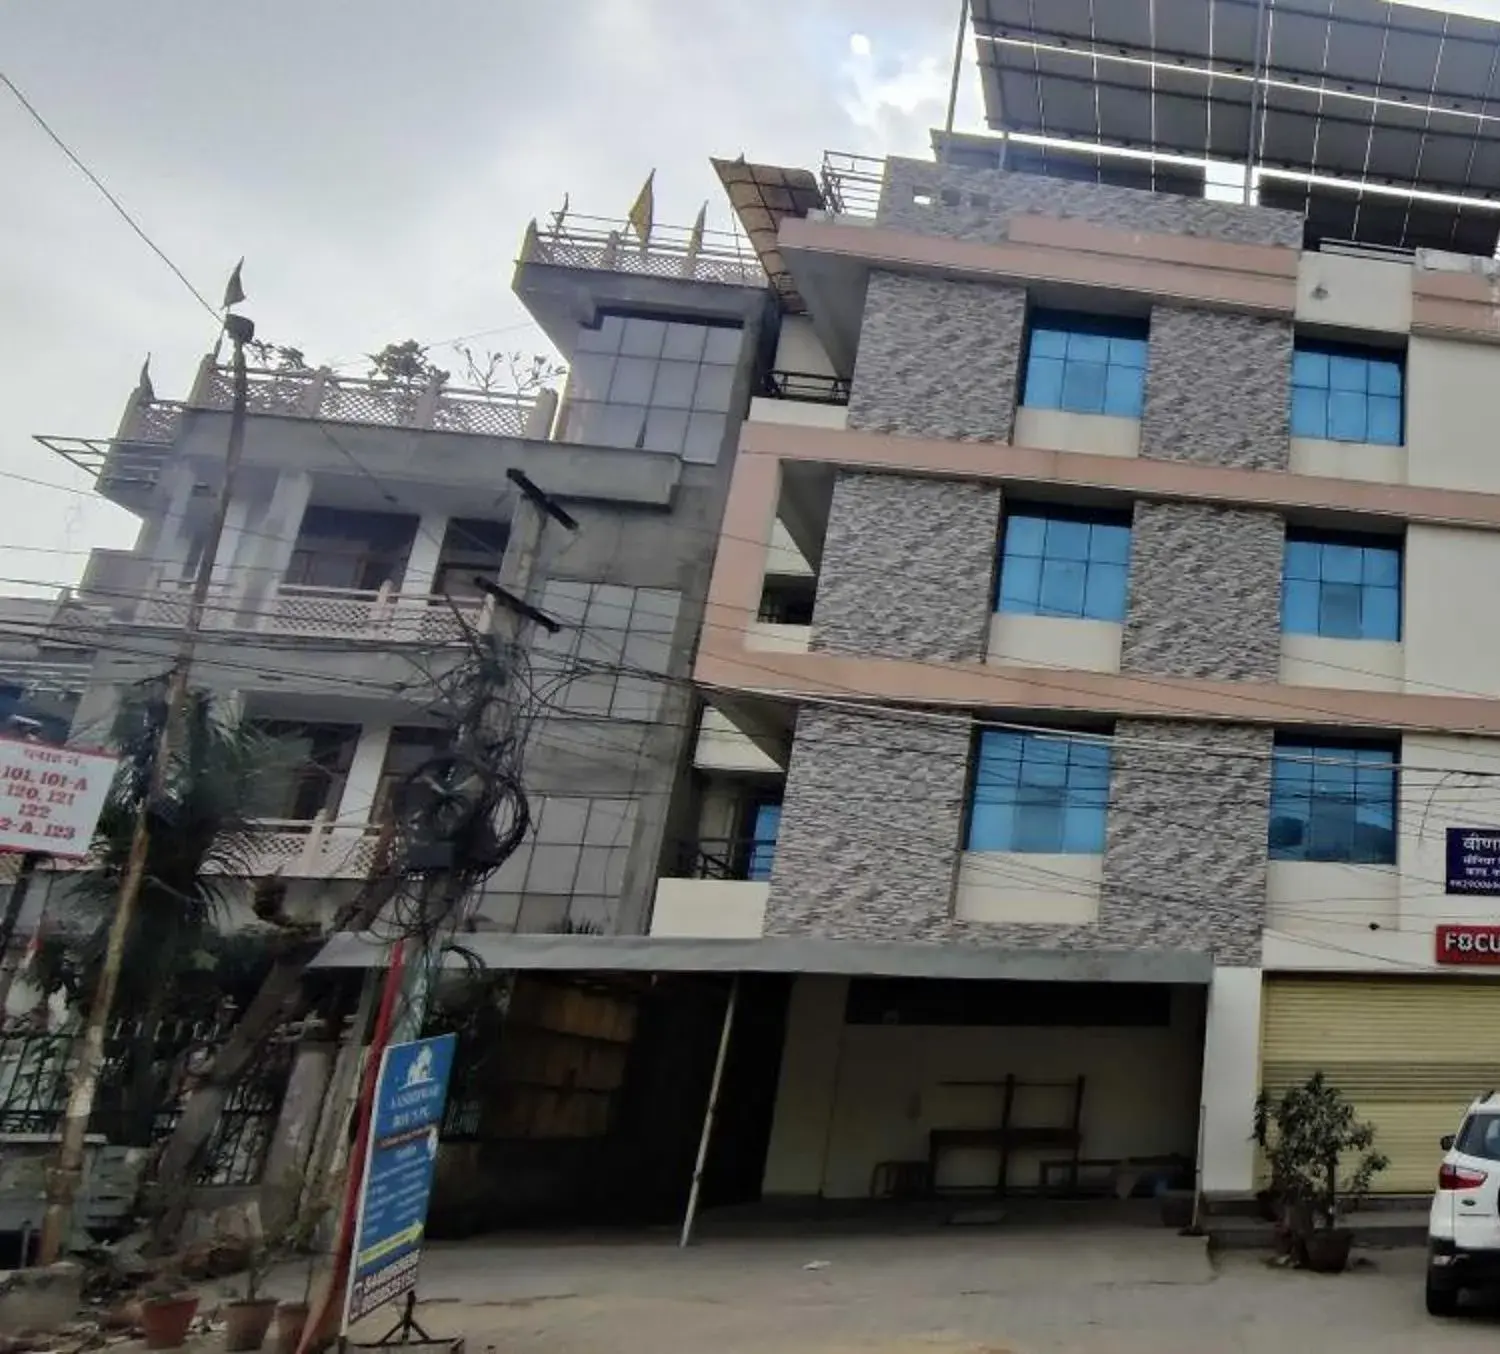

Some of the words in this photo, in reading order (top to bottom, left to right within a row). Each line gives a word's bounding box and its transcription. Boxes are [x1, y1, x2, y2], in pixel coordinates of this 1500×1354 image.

[41, 772, 88, 791] 101-A
[48, 790, 76, 806] 121
[18, 804, 52, 818] 122
[44, 824, 76, 840] 123
